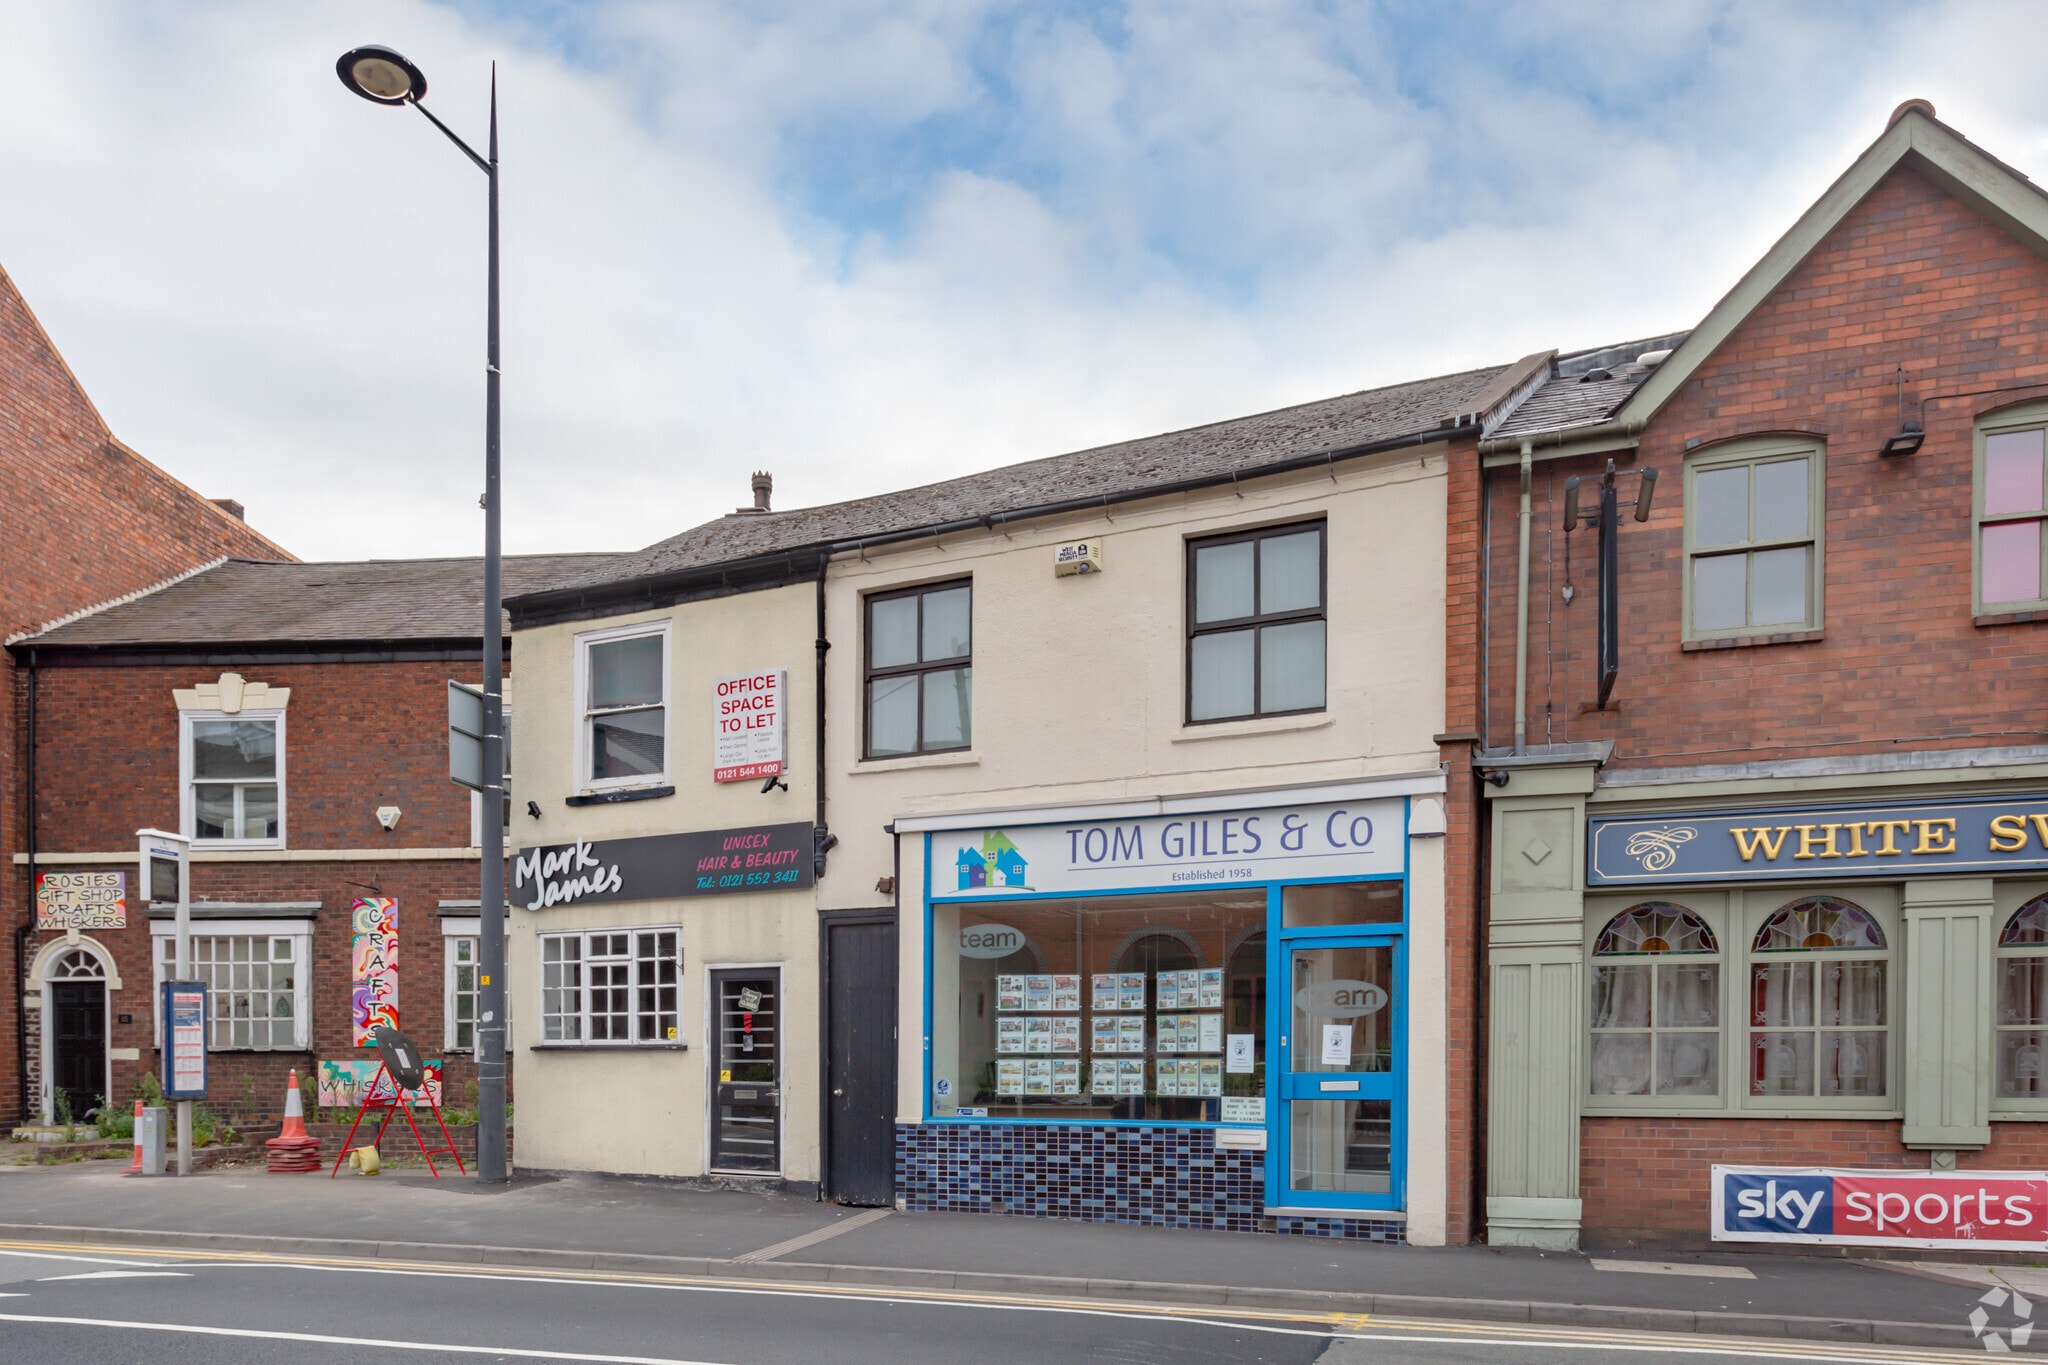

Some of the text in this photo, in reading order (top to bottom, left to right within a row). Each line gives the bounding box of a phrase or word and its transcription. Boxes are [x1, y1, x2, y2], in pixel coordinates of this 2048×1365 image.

[717, 674, 777, 696] OFFICE
[721, 694, 775, 715] SPACE
[720, 713, 777, 733] TO LET
[717, 763, 778, 780] 0121 544 1400
[723, 833, 771, 851] UNISEX
[1066, 825, 1144, 864] TOM
[1161, 816, 1262, 858] GILES
[1280, 814, 1309, 851] &
[1729, 817, 1957, 861] WHITE
[516, 836, 599, 888] Mark
[697, 849, 799, 872] HAIR & BEAUTY
[45, 875, 117, 888] ROSIES
[696, 869, 799, 889] Tel: 0121 552 3411
[1172, 868, 1252, 881] Established 1958
[38, 889, 123, 903] GIFT SHOP
[527, 864, 622, 911] James
[47, 903, 116, 915] CRAFTS
[39, 916, 126, 928] WHISKERS
[960, 931, 1017, 948] team
[321, 1079, 437, 1094] WHISKS
[1737, 1180, 2033, 1231] sky sports
